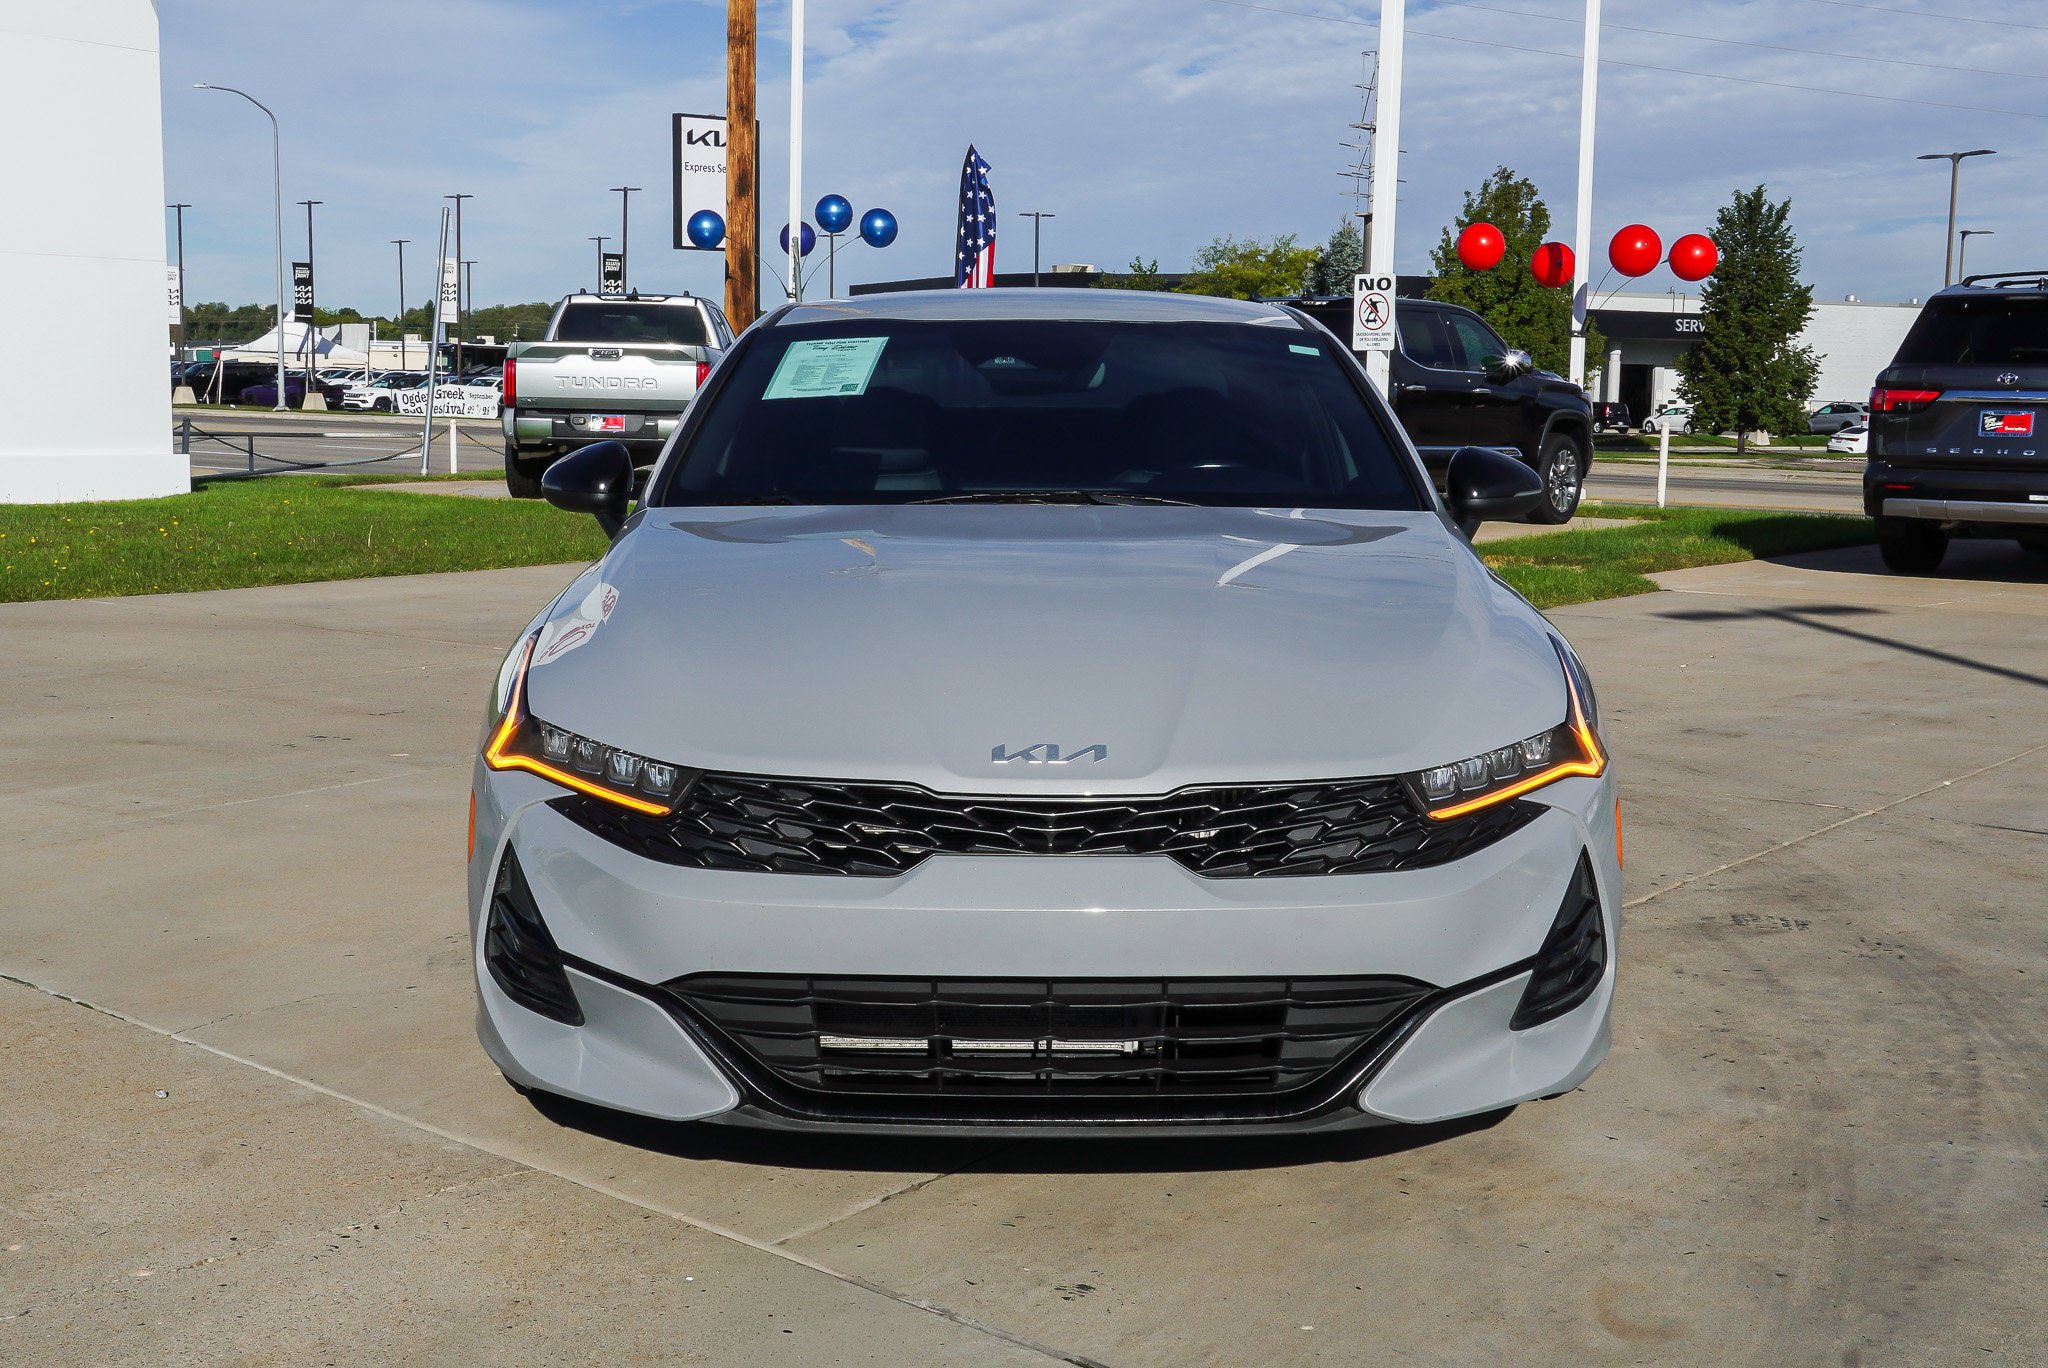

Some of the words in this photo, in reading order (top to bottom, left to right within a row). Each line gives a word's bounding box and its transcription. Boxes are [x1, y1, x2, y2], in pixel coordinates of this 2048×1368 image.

[684, 162, 716, 173] Express
[604, 279, 622, 287] KIA
[1358, 277, 1392, 291] NO
[553, 375, 658, 391] TUNDRA
[434, 387, 465, 400] Greek
[428, 402, 466, 415] estival
[991, 743, 1108, 764] KIA
